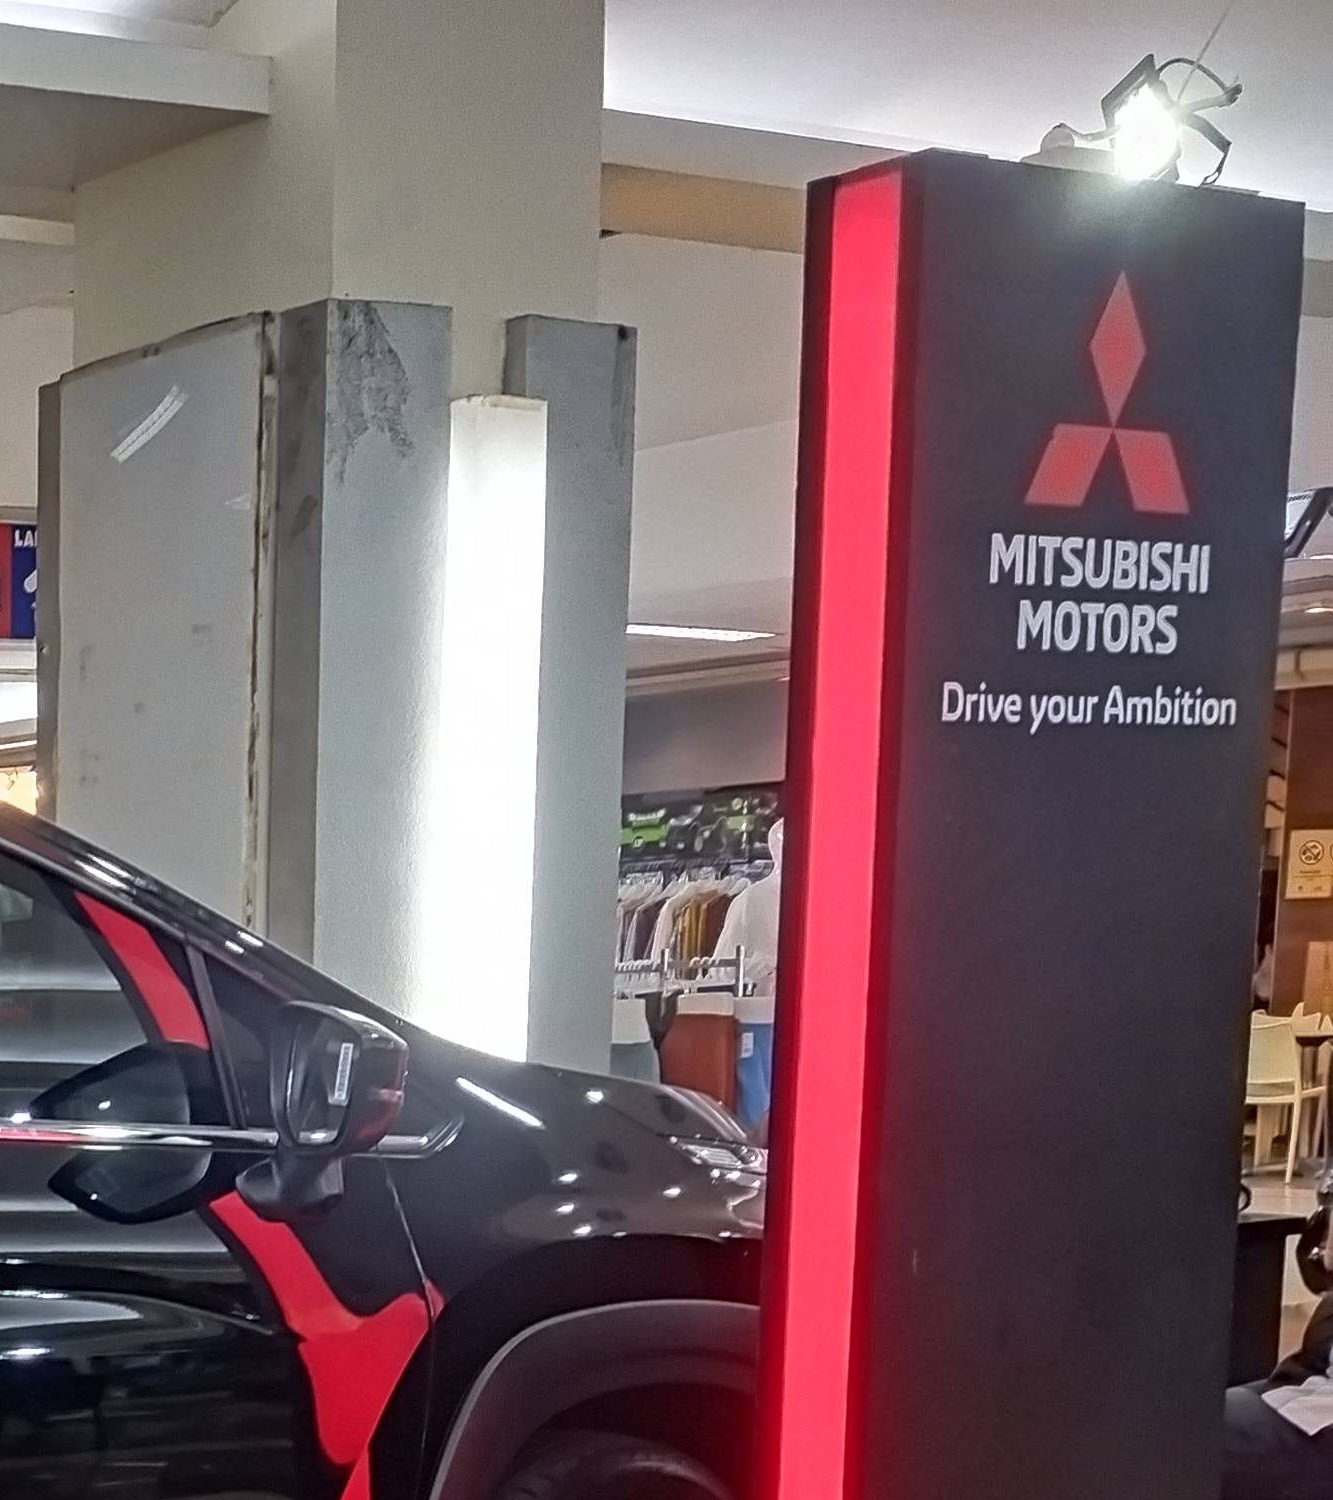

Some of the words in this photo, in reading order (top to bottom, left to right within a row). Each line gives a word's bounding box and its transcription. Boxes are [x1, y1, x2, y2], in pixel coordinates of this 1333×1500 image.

[14, 529, 37, 548] LA
[988, 532, 1211, 595] MITSUBISHI
[1016, 599, 1178, 655] MOTORS
[941, 681, 1022, 725] Drive
[1030, 690, 1099, 736] your
[1103, 684, 1237, 726] Ambition
